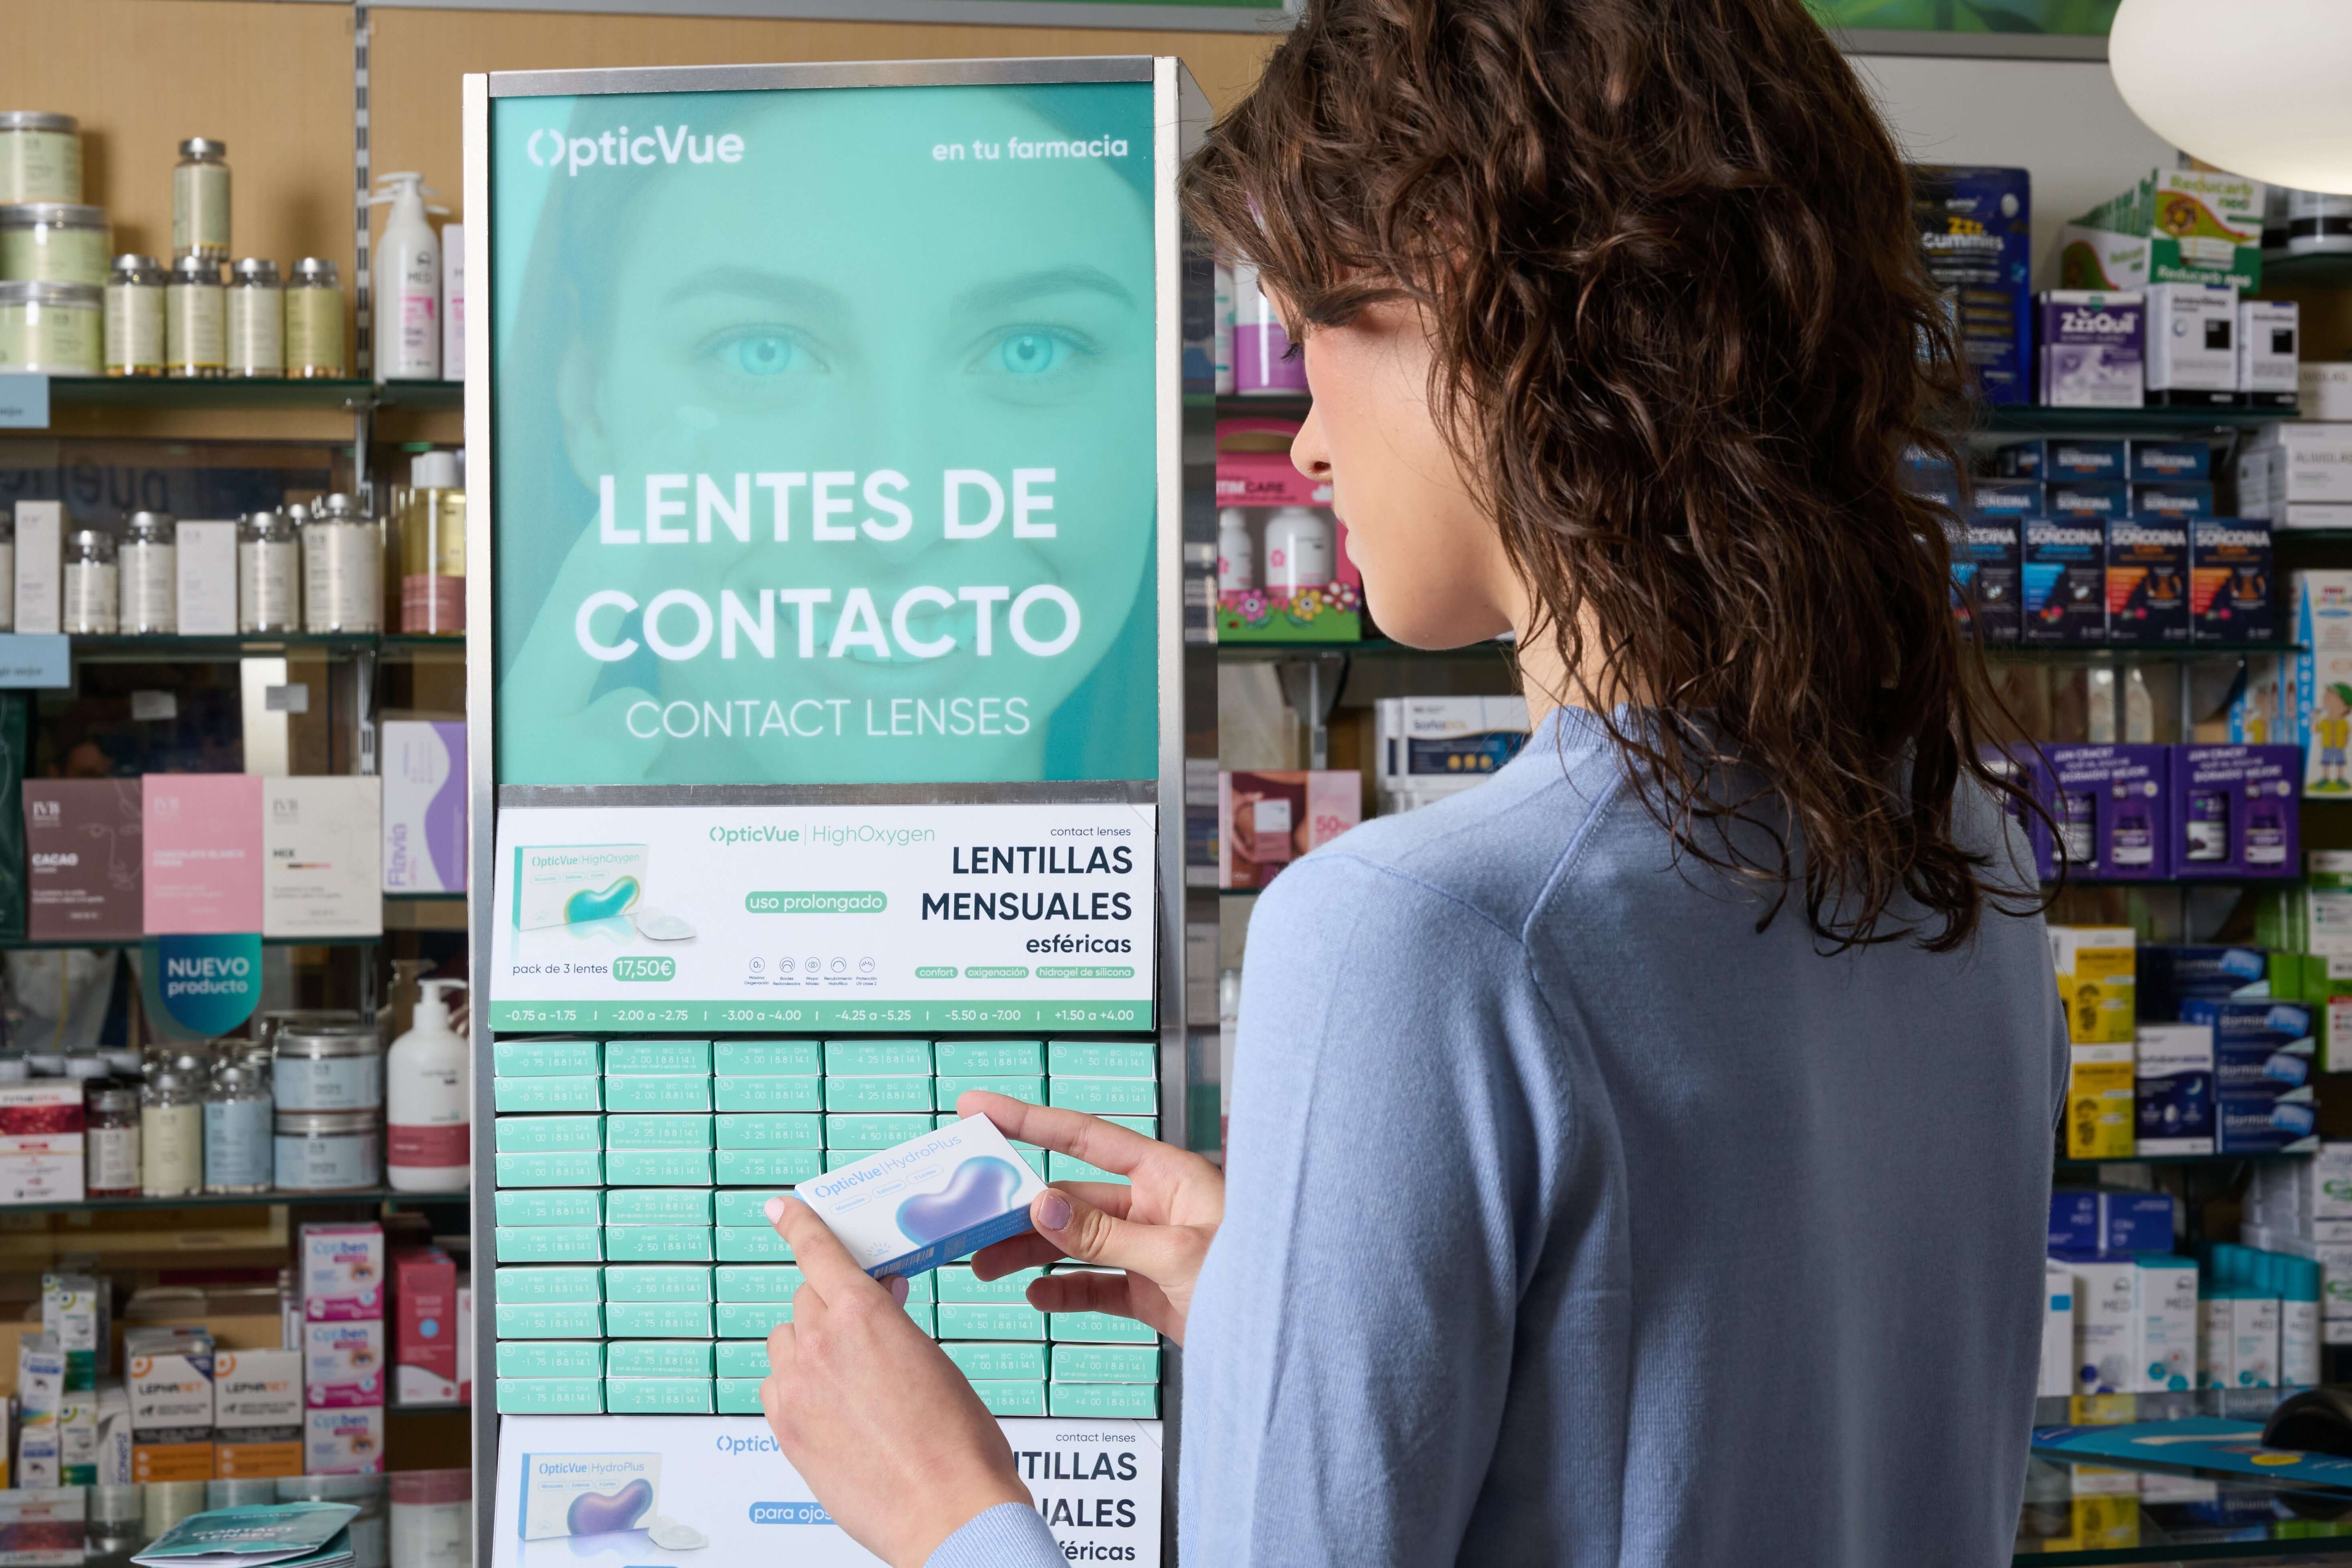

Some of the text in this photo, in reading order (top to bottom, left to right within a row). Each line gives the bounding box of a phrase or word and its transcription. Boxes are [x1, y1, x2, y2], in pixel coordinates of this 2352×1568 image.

[528, 124, 745, 177] OpticVue
[932, 135, 1129, 162] en tu farmacia
[599, 468, 1057, 544] LENTES DE
[575, 584, 1082, 662] CONTACTO
[626, 697, 1030, 740] CONTACT LENSES
[709, 825, 935, 846] OpticVue HighOxygen
[1050, 826, 1131, 836] contact lenses
[32, 853, 78, 867] CACAO
[386, 822, 407, 886] Flavia
[532, 853, 639, 868] OpticVue HighOxygen
[953, 846, 1133, 875] LENTILLAS
[750, 893, 883, 912] uso prolongado
[922, 892, 1132, 921] MENSUALES
[1026, 934, 1131, 953] esféricas
[167, 957, 250, 978] NUEVO
[512, 960, 672, 979] pack de 3 lentes 17,50€
[919, 966, 1131, 978] confort oxigenación hidrogel de silicona
[167, 978, 249, 998] producto
[506, 1010, 577, 1021] -0.75 a -1.75
[612, 1010, 688, 1021] -2.00 a -2.75
[721, 1010, 802, 1021] -3.00 a -4.00
[835, 1010, 911, 1021] -4.25 a -5.25
[945, 1010, 1021, 1021] -5.50 a -7.00
[1054, 1010, 1134, 1021] +1.50 a +4.00
[815, 1134, 962, 1199] OpticVue HydroPlus
[717, 1435, 781, 1456] OpticV
[1056, 1432, 1136, 1443] contact lenses
[539, 1461, 644, 1476] OpticVue HydroPlus
[1014, 1451, 1137, 1481] TILLAS
[754, 1508, 795, 1521] para
[1059, 1540, 1136, 1561] éricas
